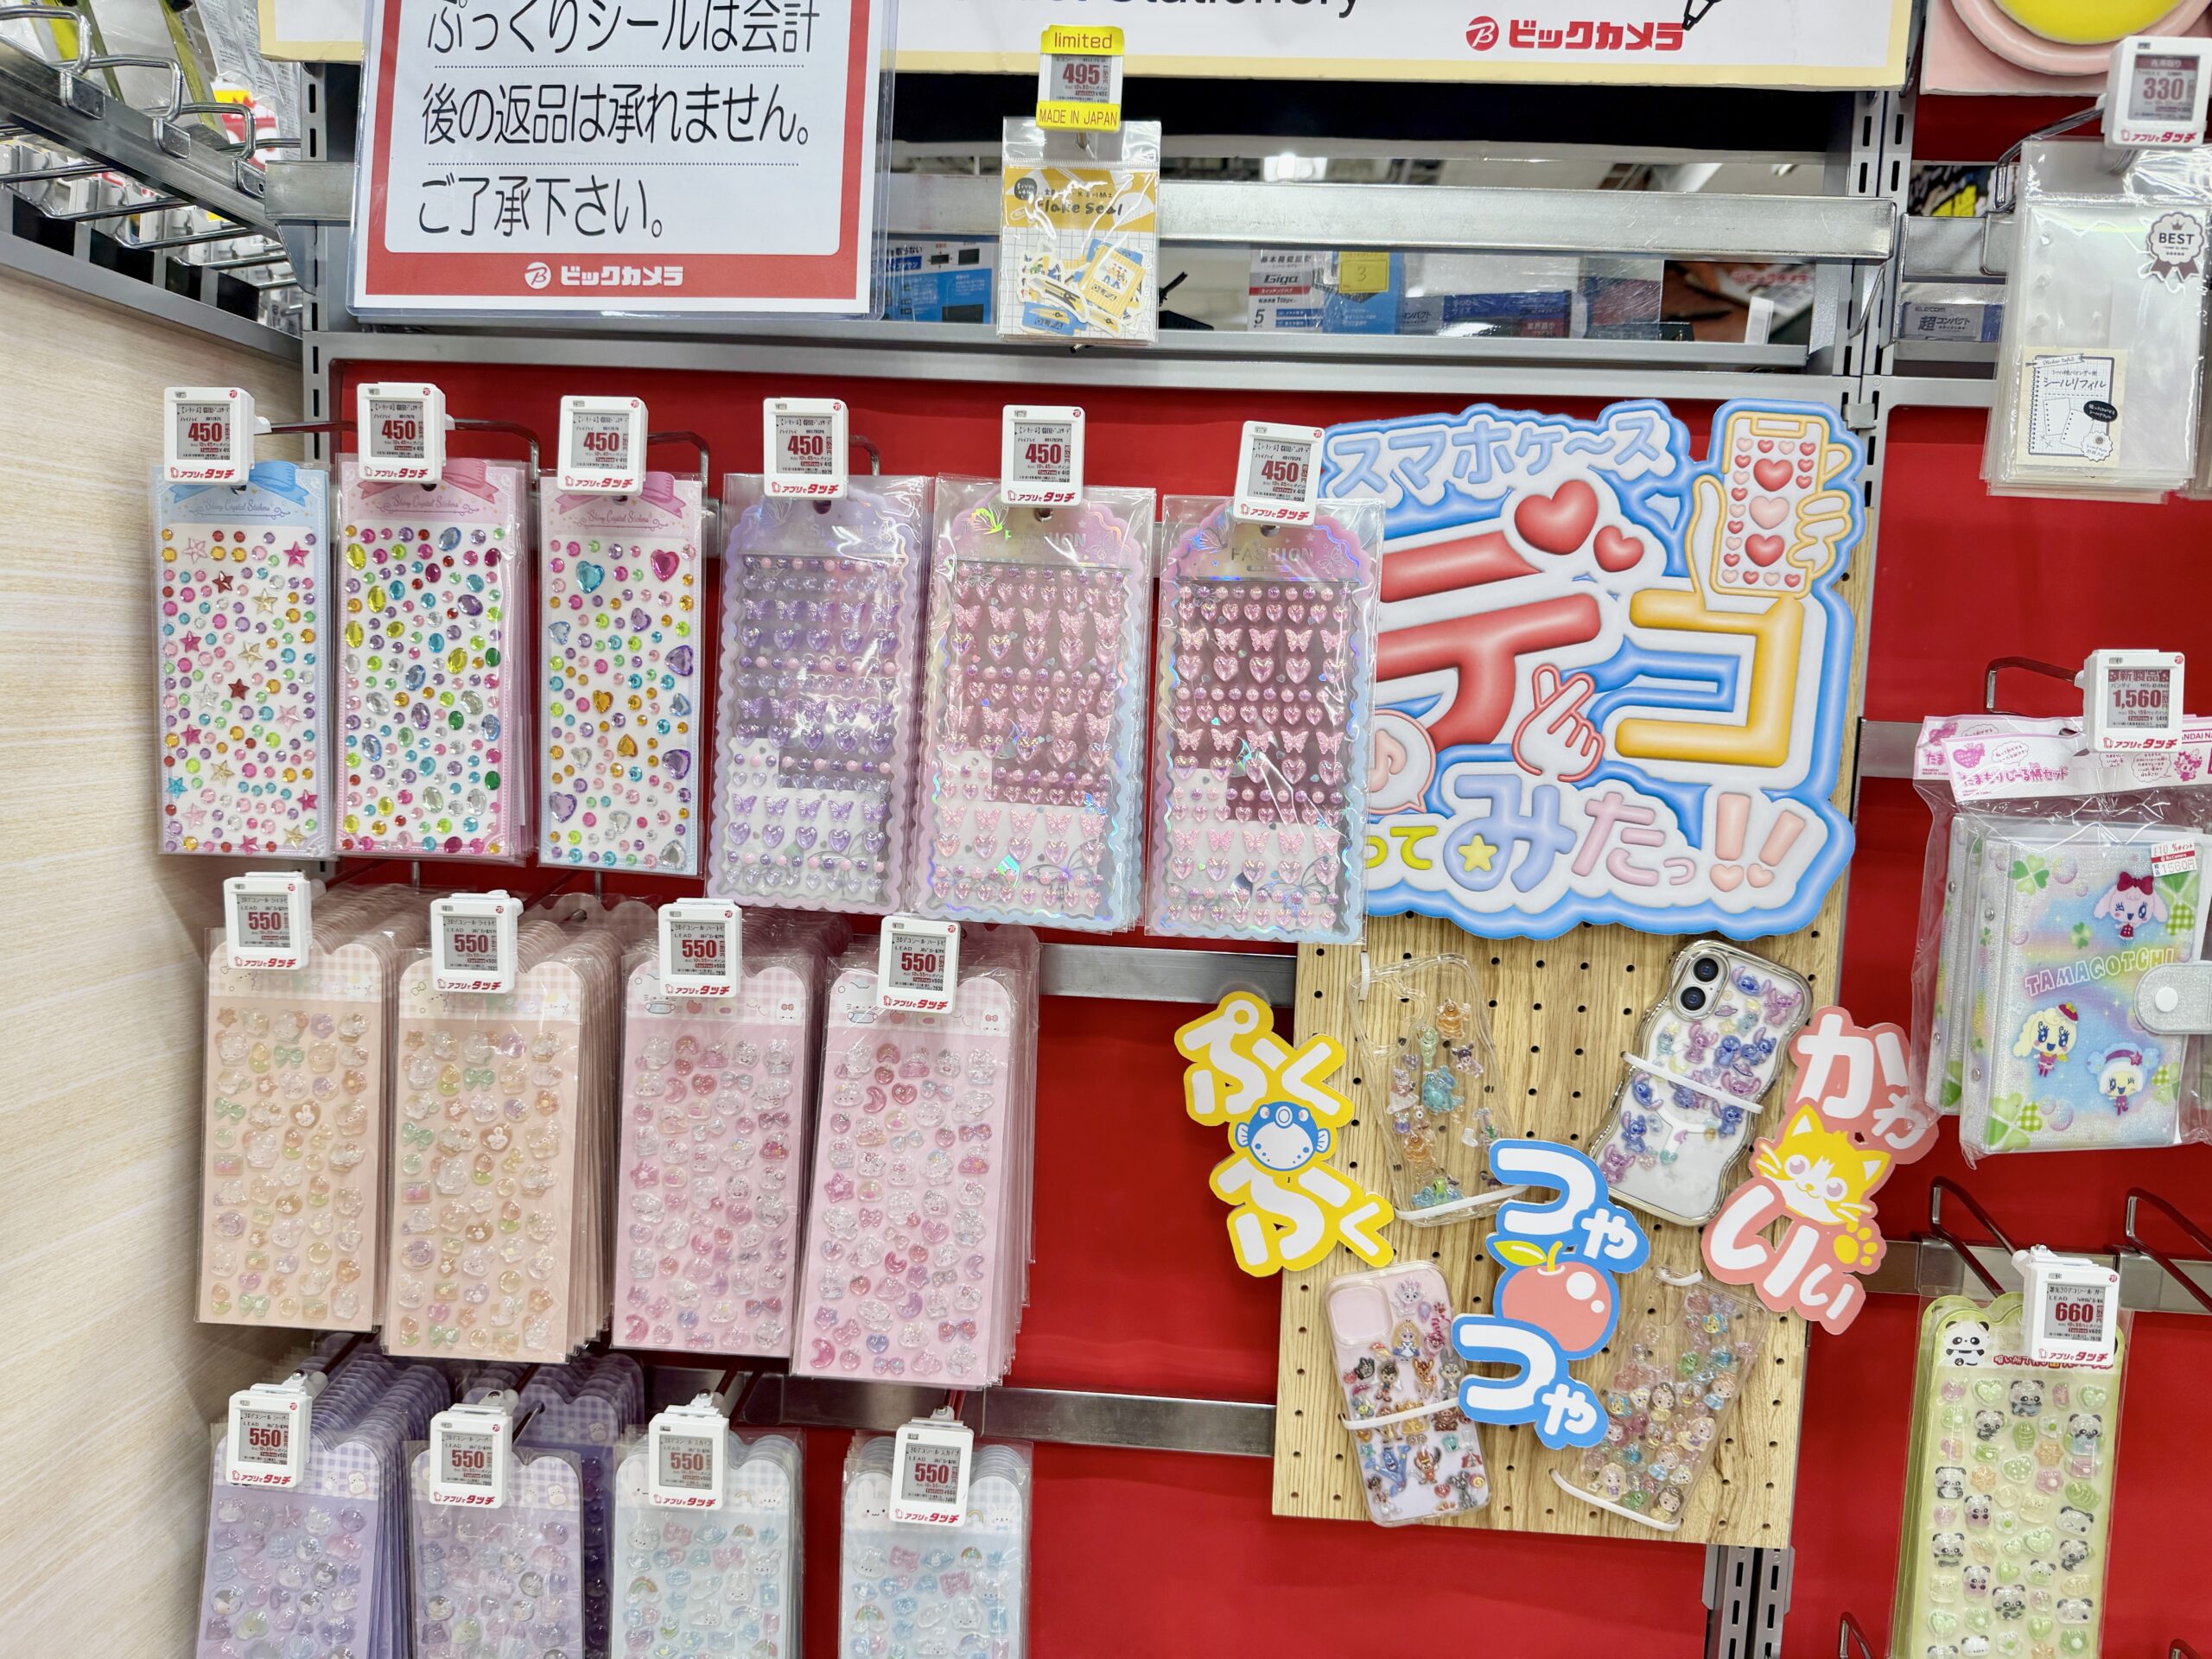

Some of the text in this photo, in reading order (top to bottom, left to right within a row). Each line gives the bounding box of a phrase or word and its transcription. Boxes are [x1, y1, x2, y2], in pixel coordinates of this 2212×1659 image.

[427, 0, 821, 54] ぷっくりシールは会計
[1509, 19, 1684, 51] ビックカメラ
[1054, 32, 1112, 48] limited
[1062, 63, 1100, 85] 495
[2143, 77, 2183, 100] 330
[423, 83, 809, 145] 後の返品は承れません。
[1039, 108, 1117, 126] MADE IN JAPAN
[419, 174, 663, 238] ご了承下さい。
[1085, 202, 1123, 215] Seal
[2158, 232, 2196, 245] BEST
[560, 264, 684, 287] ビックカメラ
[1264, 274, 1299, 285] Giga
[1357, 266, 1367, 282] 3
[1254, 308, 1265, 324] 5
[2044, 378, 2107, 391] シールリフィル
[188, 423, 222, 442] 450
[382, 420, 416, 440] 450
[583, 432, 620, 452] 450
[787, 435, 823, 455] 450
[1025, 443, 1062, 464] 450
[180, 468, 235, 479] アプリでタッチ
[374, 468, 429, 478] アプリでタッチ
[1261, 460, 1300, 482] 450
[575, 478, 633, 488] アプリでタッチ
[782, 484, 839, 494] アプリでタッチ
[1017, 492, 1076, 502] アプリでタッチ
[1249, 508, 1310, 521] アプリでタッチ
[1231, 548, 1313, 561] FASHION
[2120, 670, 2159, 682] 新製品
[2113, 690, 2161, 709] 1,560
[2114, 738, 2178, 748] アプリでタッチ
[248, 912, 282, 930] 550
[454, 934, 489, 953] 550
[682, 939, 716, 958] 550
[244, 958, 296, 968] アプリでタッチ
[901, 951, 936, 973] 550
[2024, 946, 2177, 997] TAMAGOTCHI
[448, 981, 501, 990] アプリでタッチ
[675, 985, 730, 995] アプリでタッチ
[892, 999, 949, 1010] アプリでタッチ
[2056, 1302, 2094, 1323] 660
[2049, 1351, 2108, 1362] アプリでタッチ
[249, 1427, 281, 1447] 550
[451, 1449, 484, 1469] 550
[671, 1452, 704, 1471] 550
[240, 1474, 291, 1484] アプリでタッチ
[914, 1462, 949, 1484] 550
[442, 1495, 495, 1505] アプリでタッチ
[663, 1497, 716, 1507] アプリでタッチ
[904, 1513, 959, 1523] アプリでタッチ
